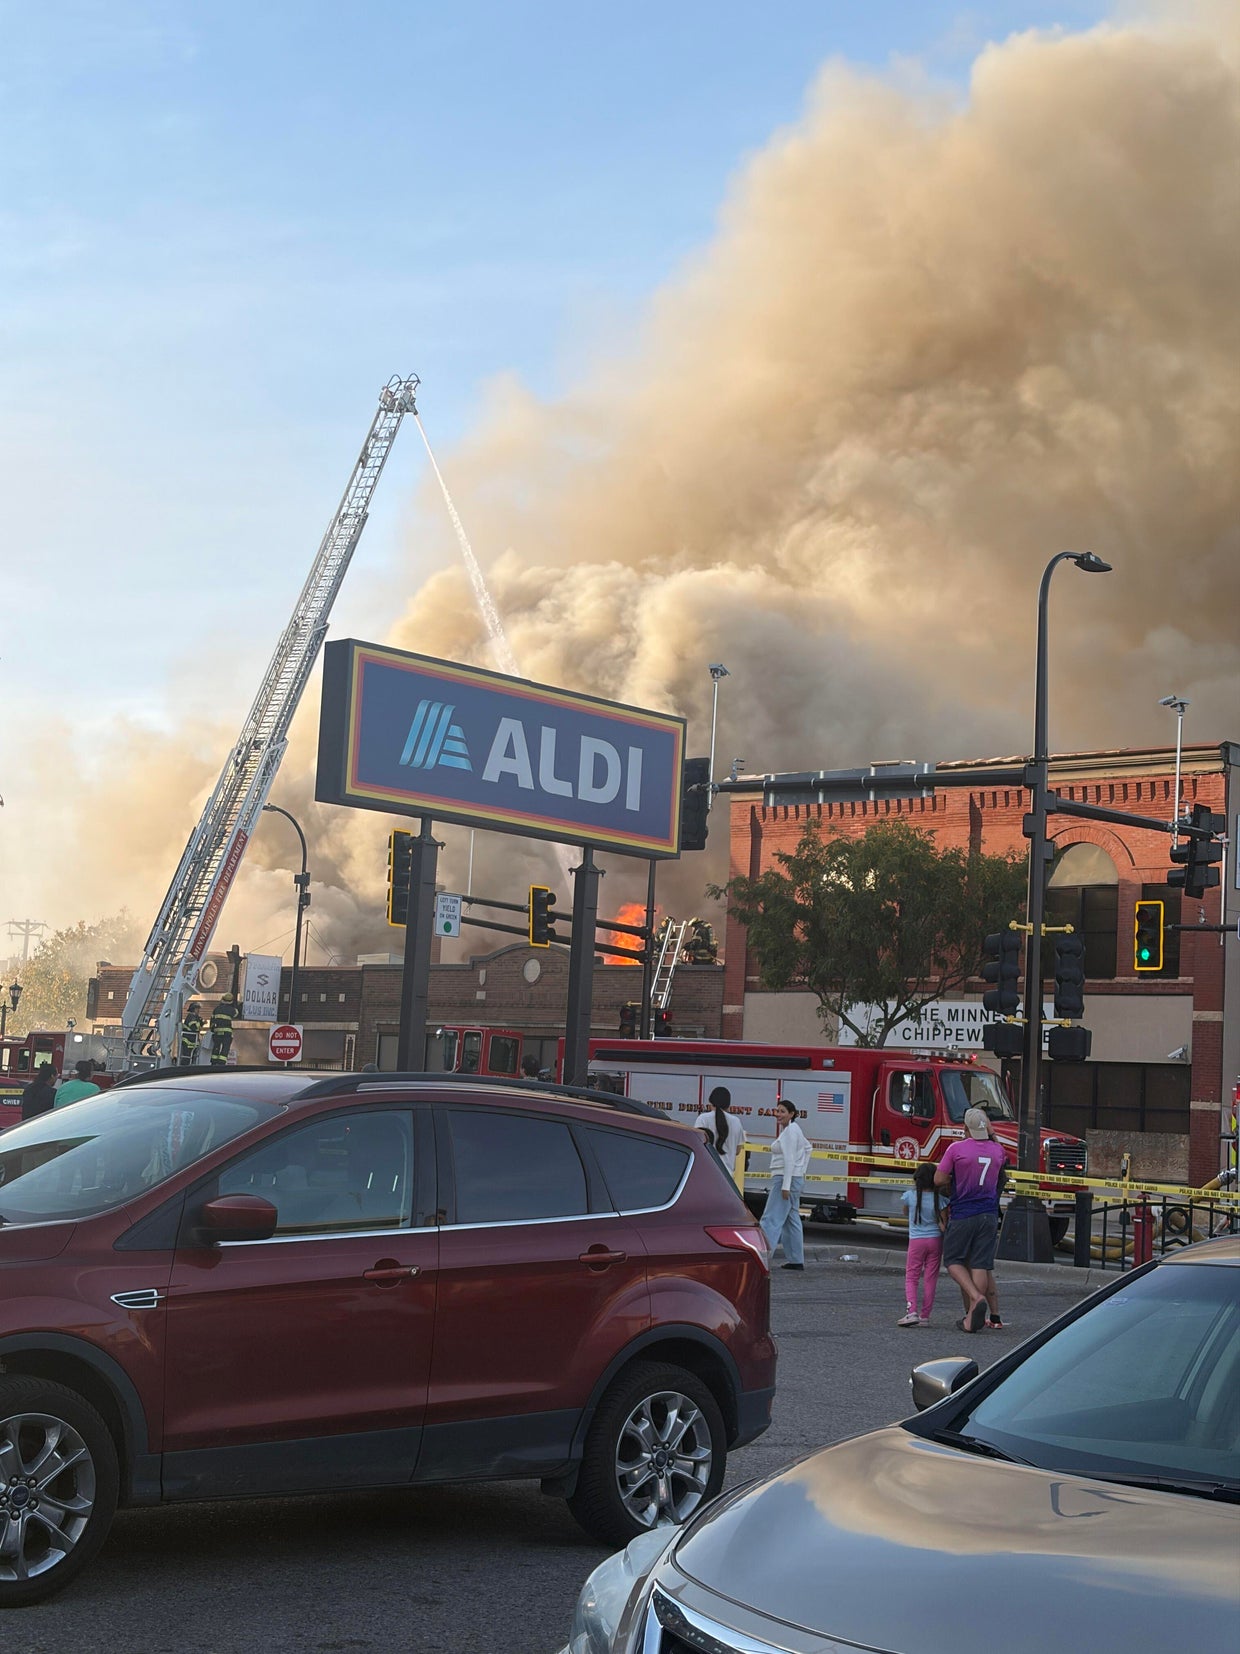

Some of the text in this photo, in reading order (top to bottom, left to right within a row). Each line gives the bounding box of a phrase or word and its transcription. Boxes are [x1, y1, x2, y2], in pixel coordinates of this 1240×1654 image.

[482, 717, 643, 811] ALDI
[192, 904, 218, 960] MINNEAPOLIS
[223, 831, 247, 882] DEPARTMENT
[246, 989, 277, 1005] DOLLAR
[978, 1156, 992, 1186] 7
